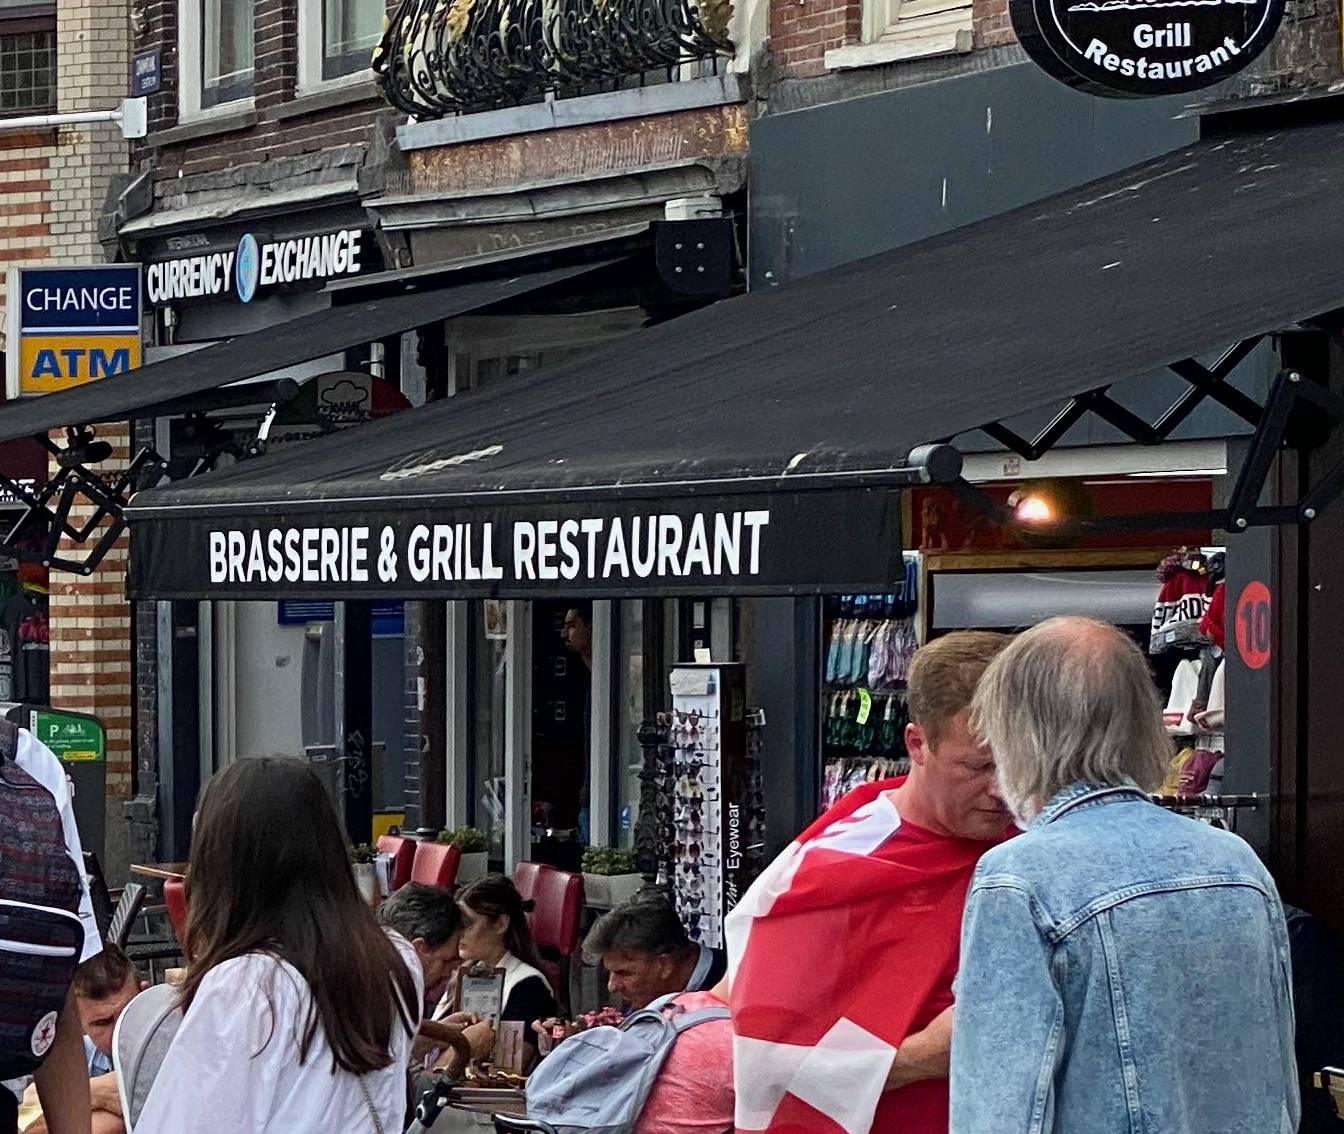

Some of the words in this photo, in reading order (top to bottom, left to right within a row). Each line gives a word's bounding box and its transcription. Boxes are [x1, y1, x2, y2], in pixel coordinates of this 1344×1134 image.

[1133, 23, 1191, 48] Grill
[1084, 36, 1242, 79] Restaurant
[147, 252, 234, 303] CURRENCY
[260, 229, 362, 285] EXCHANGE
[27, 287, 132, 311] CHANGE
[32, 349, 130, 379] ATM
[210, 527, 369, 583] BRASSERIE
[377, 525, 398, 583] &
[408, 522, 502, 581] GRILL
[513, 510, 769, 581] RESTAURANT
[1244, 601, 1270, 653] 10
[50, 725, 60, 737] P
[726, 802, 743, 869] Eyewear
